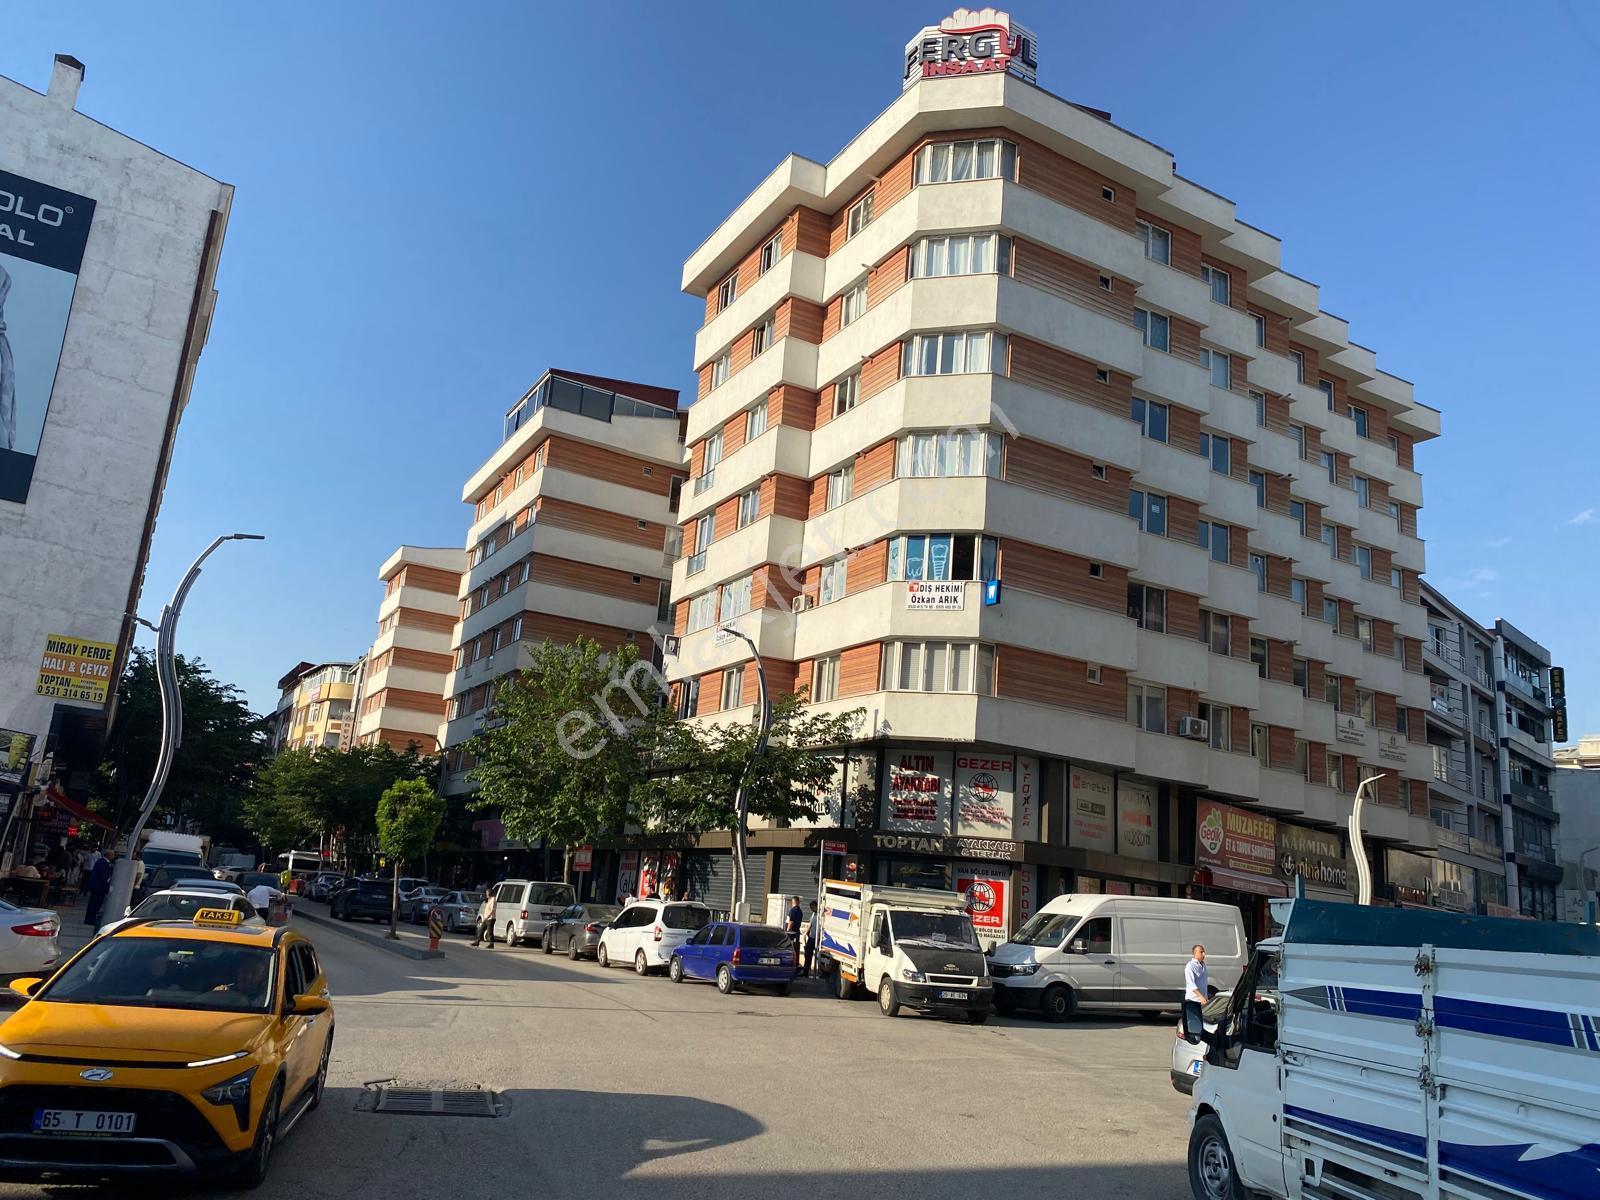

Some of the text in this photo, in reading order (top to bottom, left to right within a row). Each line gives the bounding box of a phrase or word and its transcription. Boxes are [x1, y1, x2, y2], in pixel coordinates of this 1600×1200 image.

[911, 594, 959, 604] Özkan ARIK
[80, 645, 112, 660] PERDE
[42, 656, 66, 671] HALI
[68, 661, 76, 673] &
[39, 674, 71, 688] TOPTAN
[37, 685, 43, 693] 0
[44, 686, 60, 696] 531
[62, 688, 78, 698] 314
[80, 690, 90, 700] 65
[94, 692, 103, 702] 19
[899, 755, 934, 772] ALTIN
[956, 757, 1013, 773] GEZER
[891, 775, 941, 793] AYAKKABI
[1226, 812, 1275, 841] MUZAFFER
[873, 835, 944, 852] TOPTAN
[956, 838, 1015, 852] AYAKKABI
[43, 1112, 133, 1131] 65 T 0101
